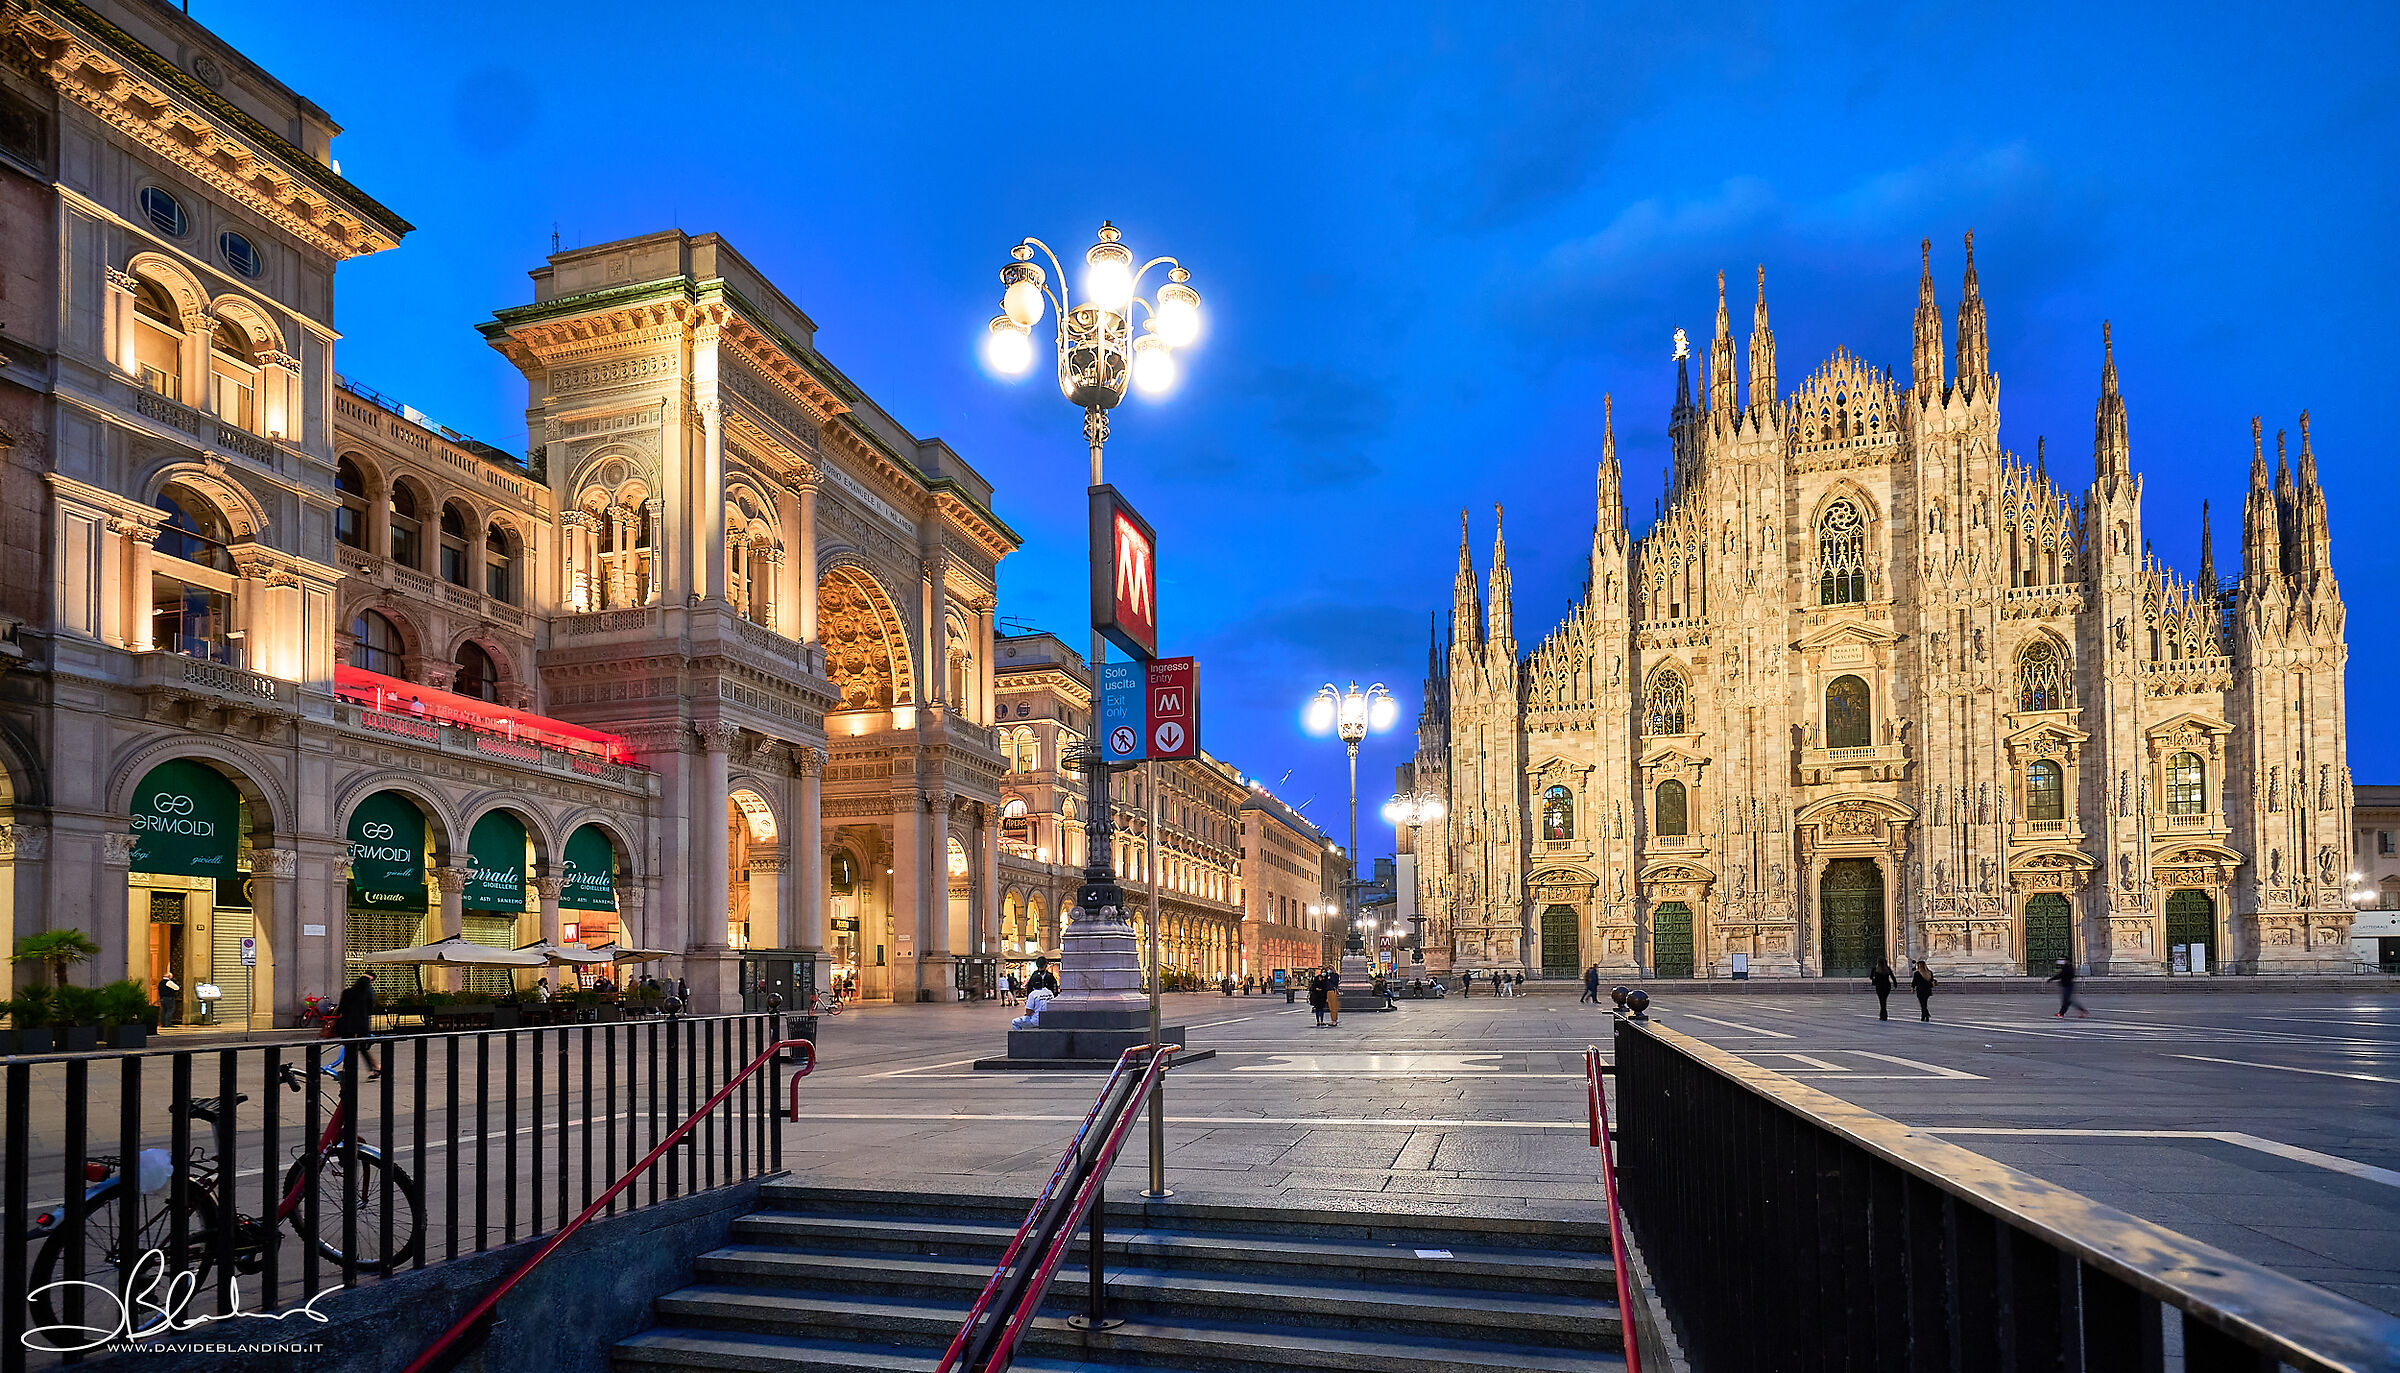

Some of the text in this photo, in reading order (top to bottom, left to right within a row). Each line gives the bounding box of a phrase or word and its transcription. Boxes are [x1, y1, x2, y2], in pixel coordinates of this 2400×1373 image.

[843, 477, 875, 506] EMANUELE
[1116, 532, 1152, 628] M
[1105, 668, 1127, 679] Solo
[1150, 663, 1189, 674] Ingresso
[1105, 679, 1136, 691] uscita
[1150, 674, 1172, 684] Entry
[1106, 694, 1126, 706] Exit
[1158, 693, 1181, 711] M
[1106, 706, 1128, 719] only
[131, 813, 214, 837] GRIMOLDI
[350, 844, 411, 863] RIMOLDI
[482, 881, 518, 891] GIOIELLERIE
[580, 884, 610, 893] GIOIELLERIE
[497, 897, 523, 905] SANREMO
[564, 924, 576, 940] M
[1380, 937, 1391, 946] M
